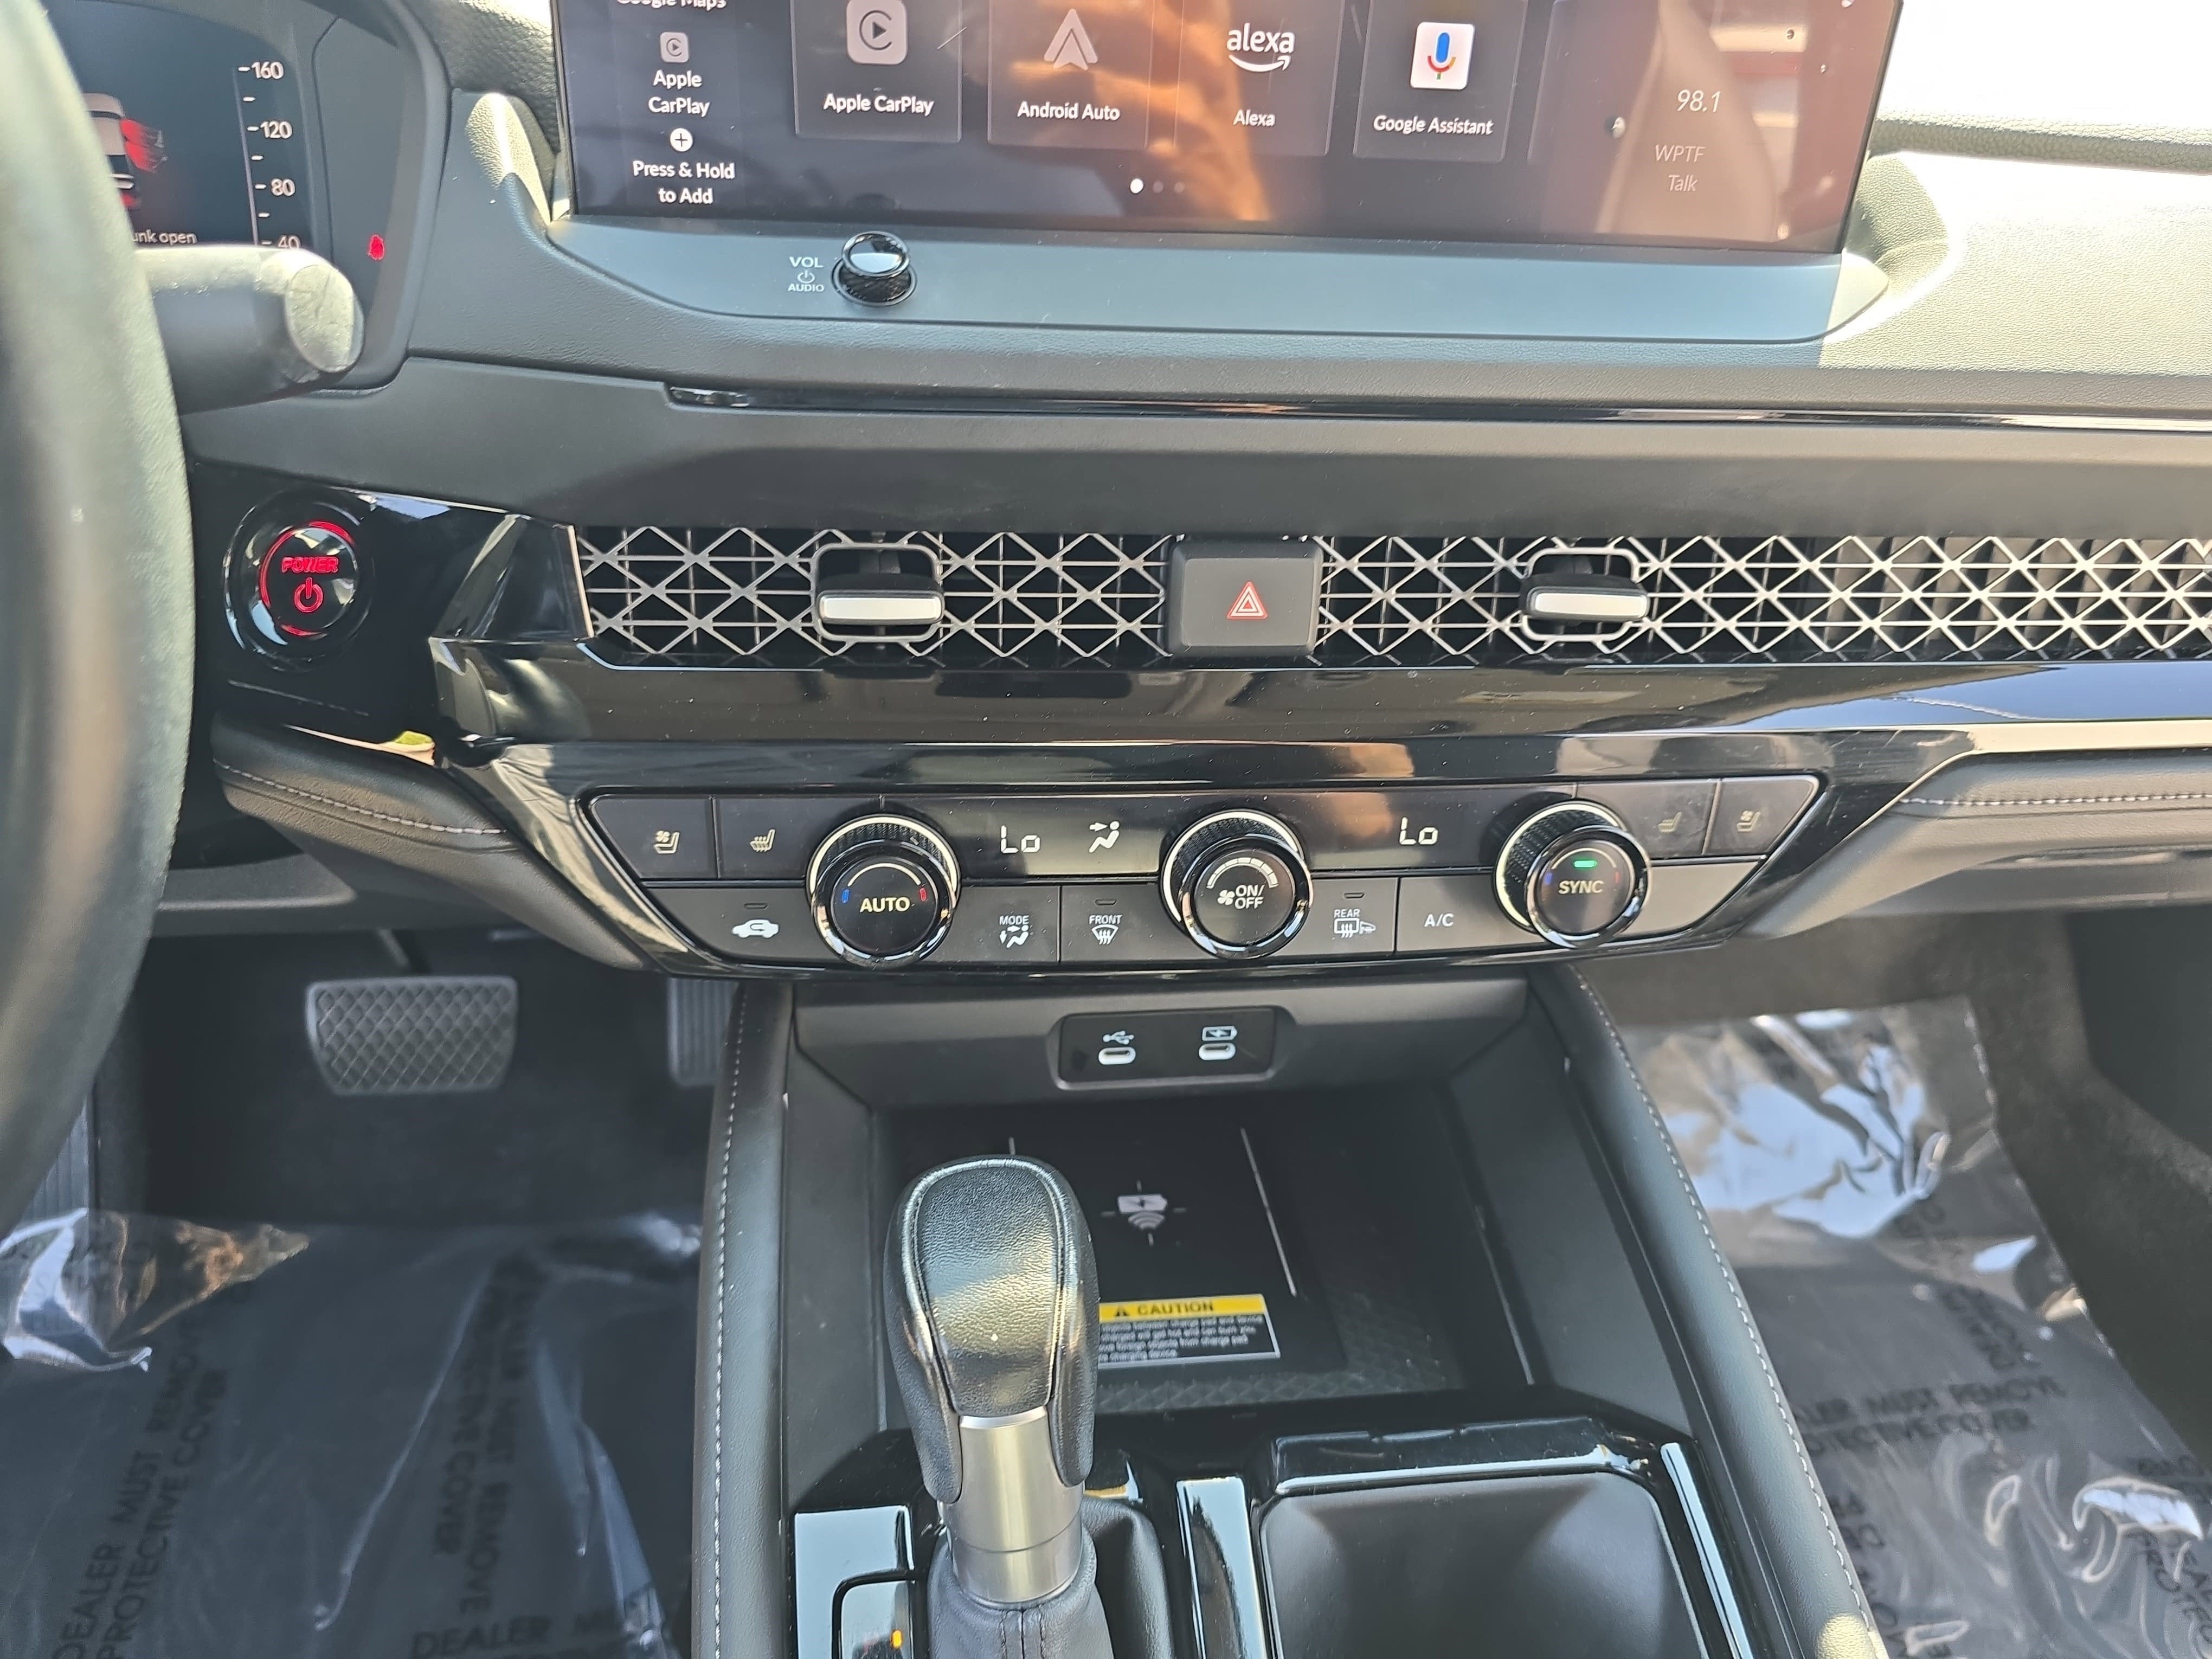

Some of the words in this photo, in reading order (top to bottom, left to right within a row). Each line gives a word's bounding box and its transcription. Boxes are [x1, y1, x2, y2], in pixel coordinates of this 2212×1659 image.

[1226, 22, 1295, 54] alexa
[251, 61, 284, 80] 160
[653, 69, 703, 90] Apple
[648, 96, 711, 118] CarPlay
[824, 93, 871, 114] Apple
[874, 95, 935, 117] CarPlay
[1676, 88, 1721, 113] 98.1
[1017, 101, 1079, 119] Android
[1082, 104, 1121, 121] Auto
[1233, 110, 1276, 127] Alexa
[260, 121, 293, 139] 120
[1373, 115, 1425, 134] Google
[1427, 117, 1495, 136] Assistant
[1655, 144, 1706, 162] WPTF
[632, 160, 676, 177] Press
[678, 162, 693, 178] &
[696, 162, 736, 179] Hold
[271, 178, 296, 196] 80
[1668, 173, 1698, 192] Talk
[658, 187, 677, 203] to
[679, 187, 714, 204] Add
[158, 232, 197, 246] open
[789, 256, 824, 268] VOL
[787, 283, 825, 293] AUDIO
[281, 557, 339, 574] POWER
[1000, 825, 1041, 854] Lo
[1399, 816, 1439, 845] Lo
[1235, 884, 1265, 896] ON/
[1558, 880, 1604, 895] SYNC
[859, 897, 911, 913] AUTO
[1234, 896, 1264, 910] OFF
[999, 915, 1030, 925] MODE
[1089, 915, 1123, 925] FRONT
[1334, 908, 1361, 918] REAR
[1424, 912, 1455, 928] A/C
[1137, 1300, 1213, 1316] CAUTION
[53, 1541, 126, 1659] DEALER
[111, 1449, 164, 1523] MUST
